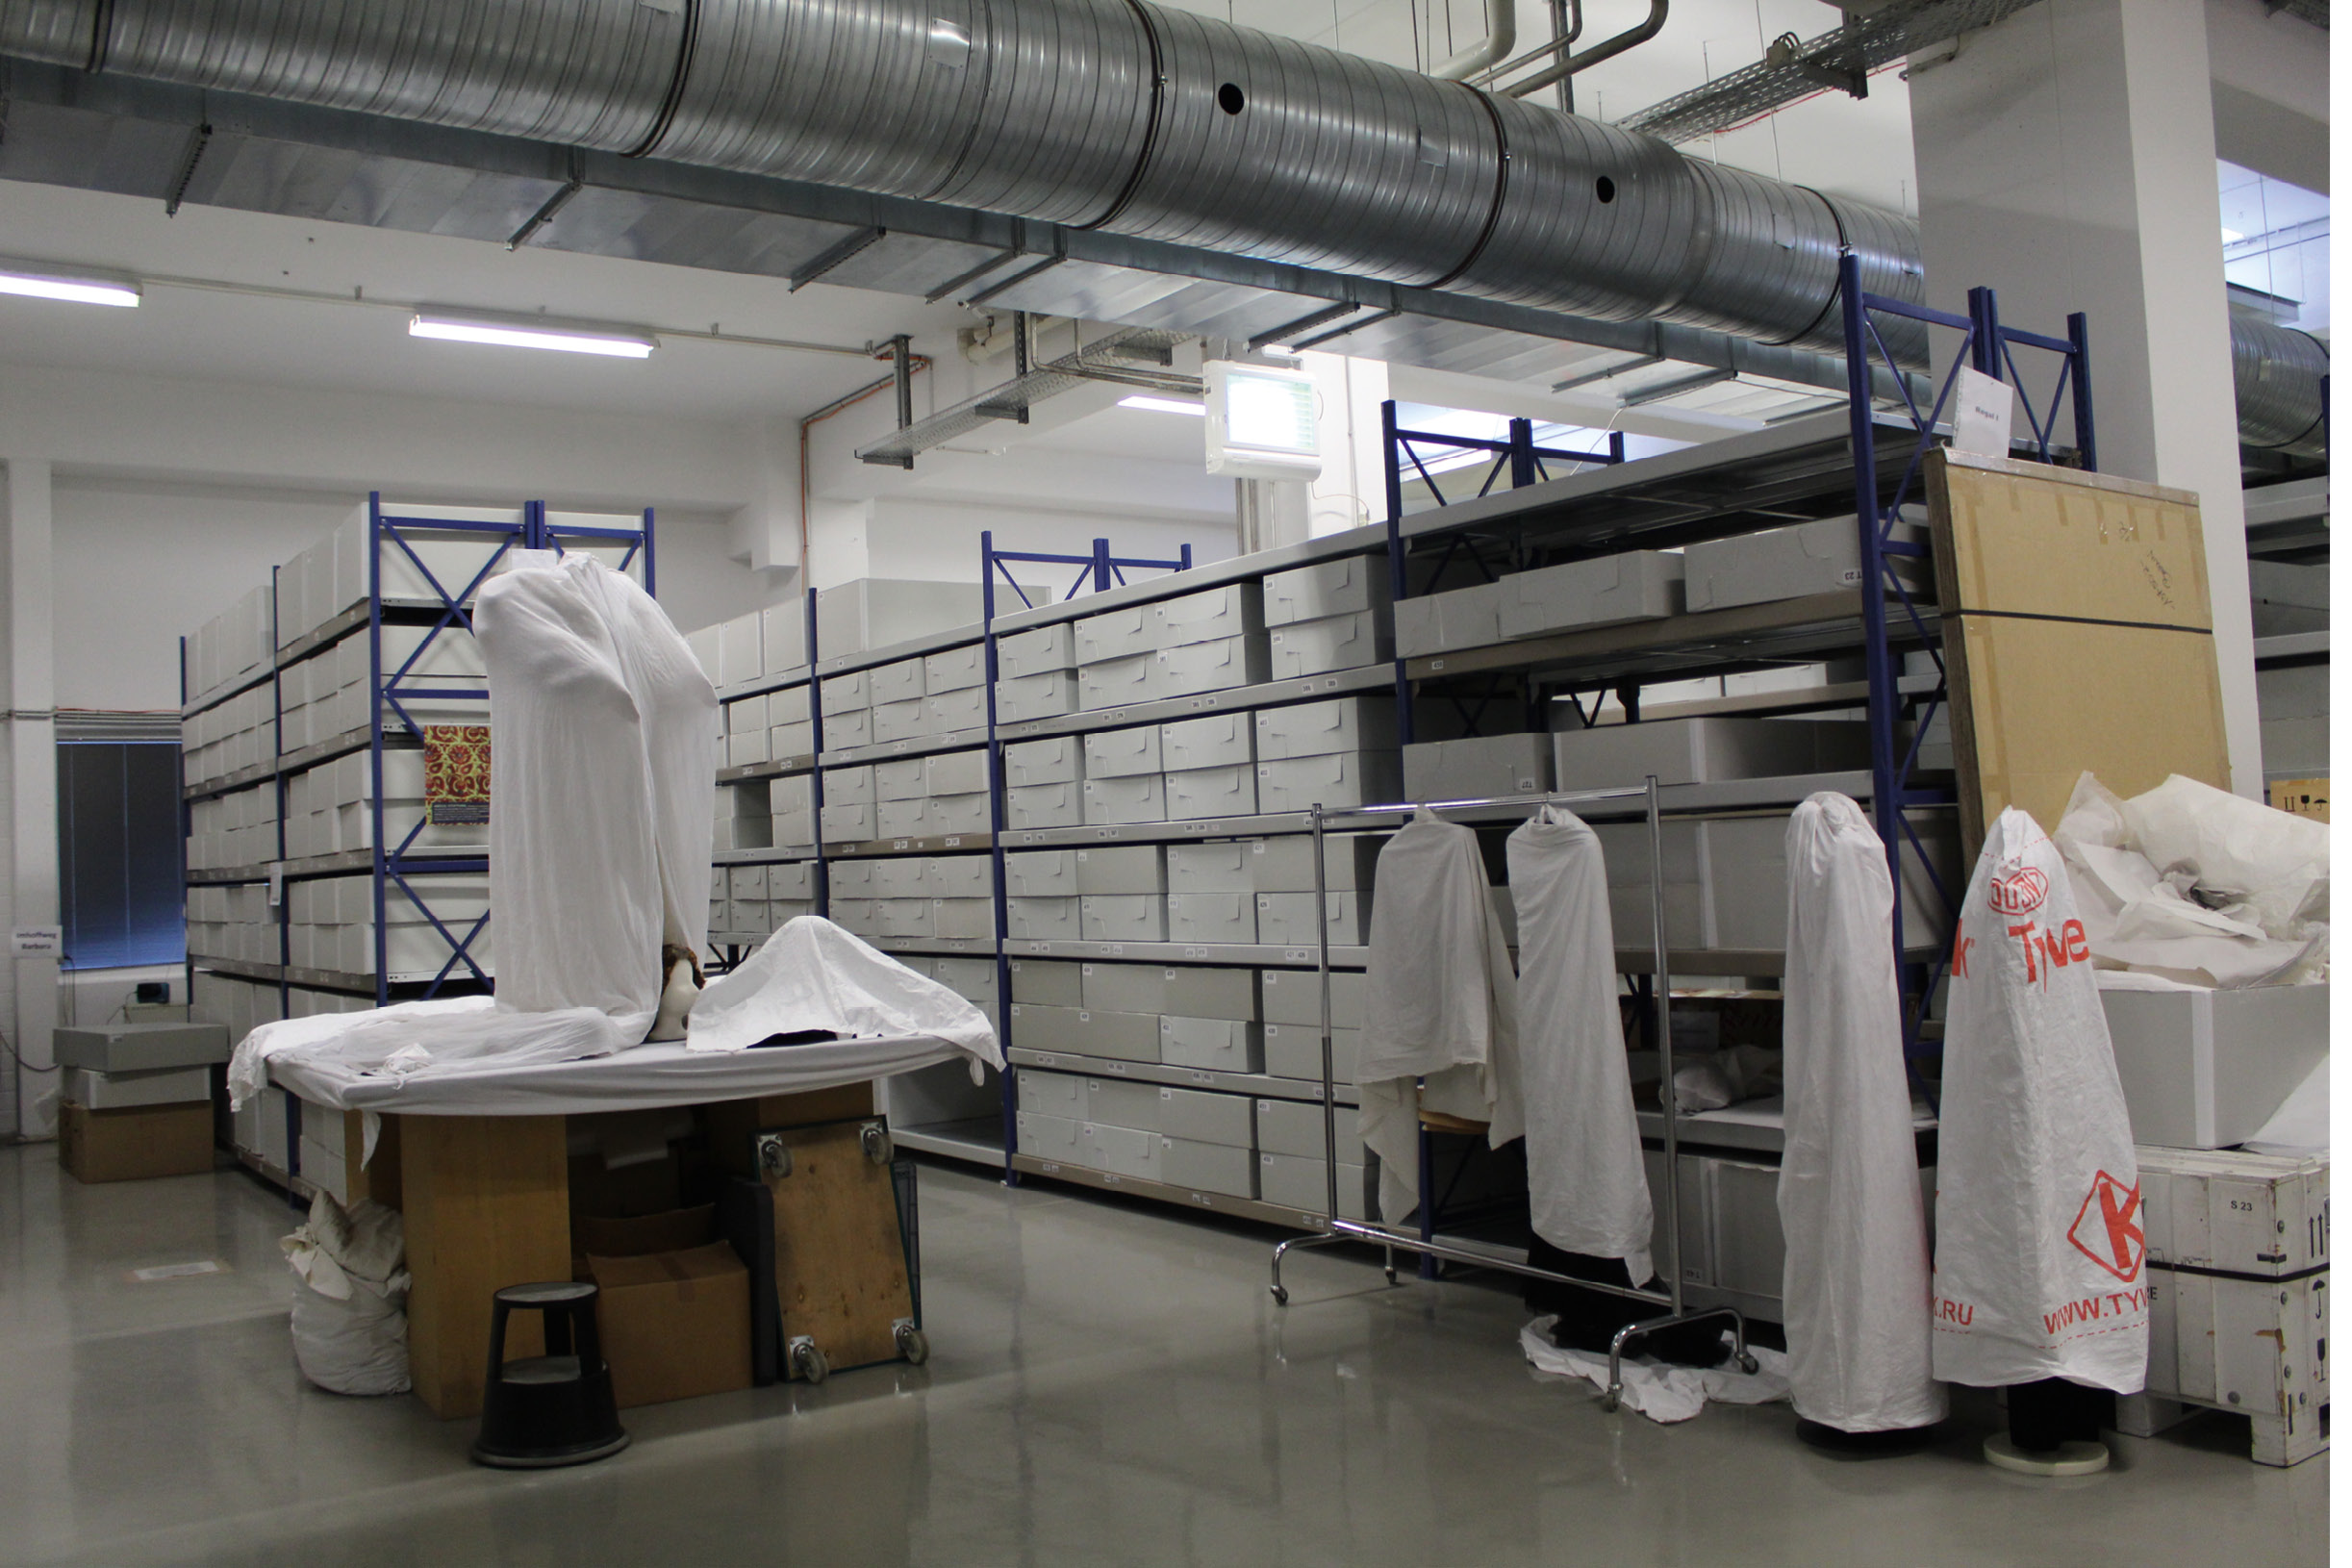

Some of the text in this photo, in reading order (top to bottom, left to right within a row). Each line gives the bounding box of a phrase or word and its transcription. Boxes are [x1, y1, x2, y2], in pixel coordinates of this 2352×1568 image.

[2098, 1181, 2143, 1269] K
[2231, 1200, 2253, 1212] S 23
